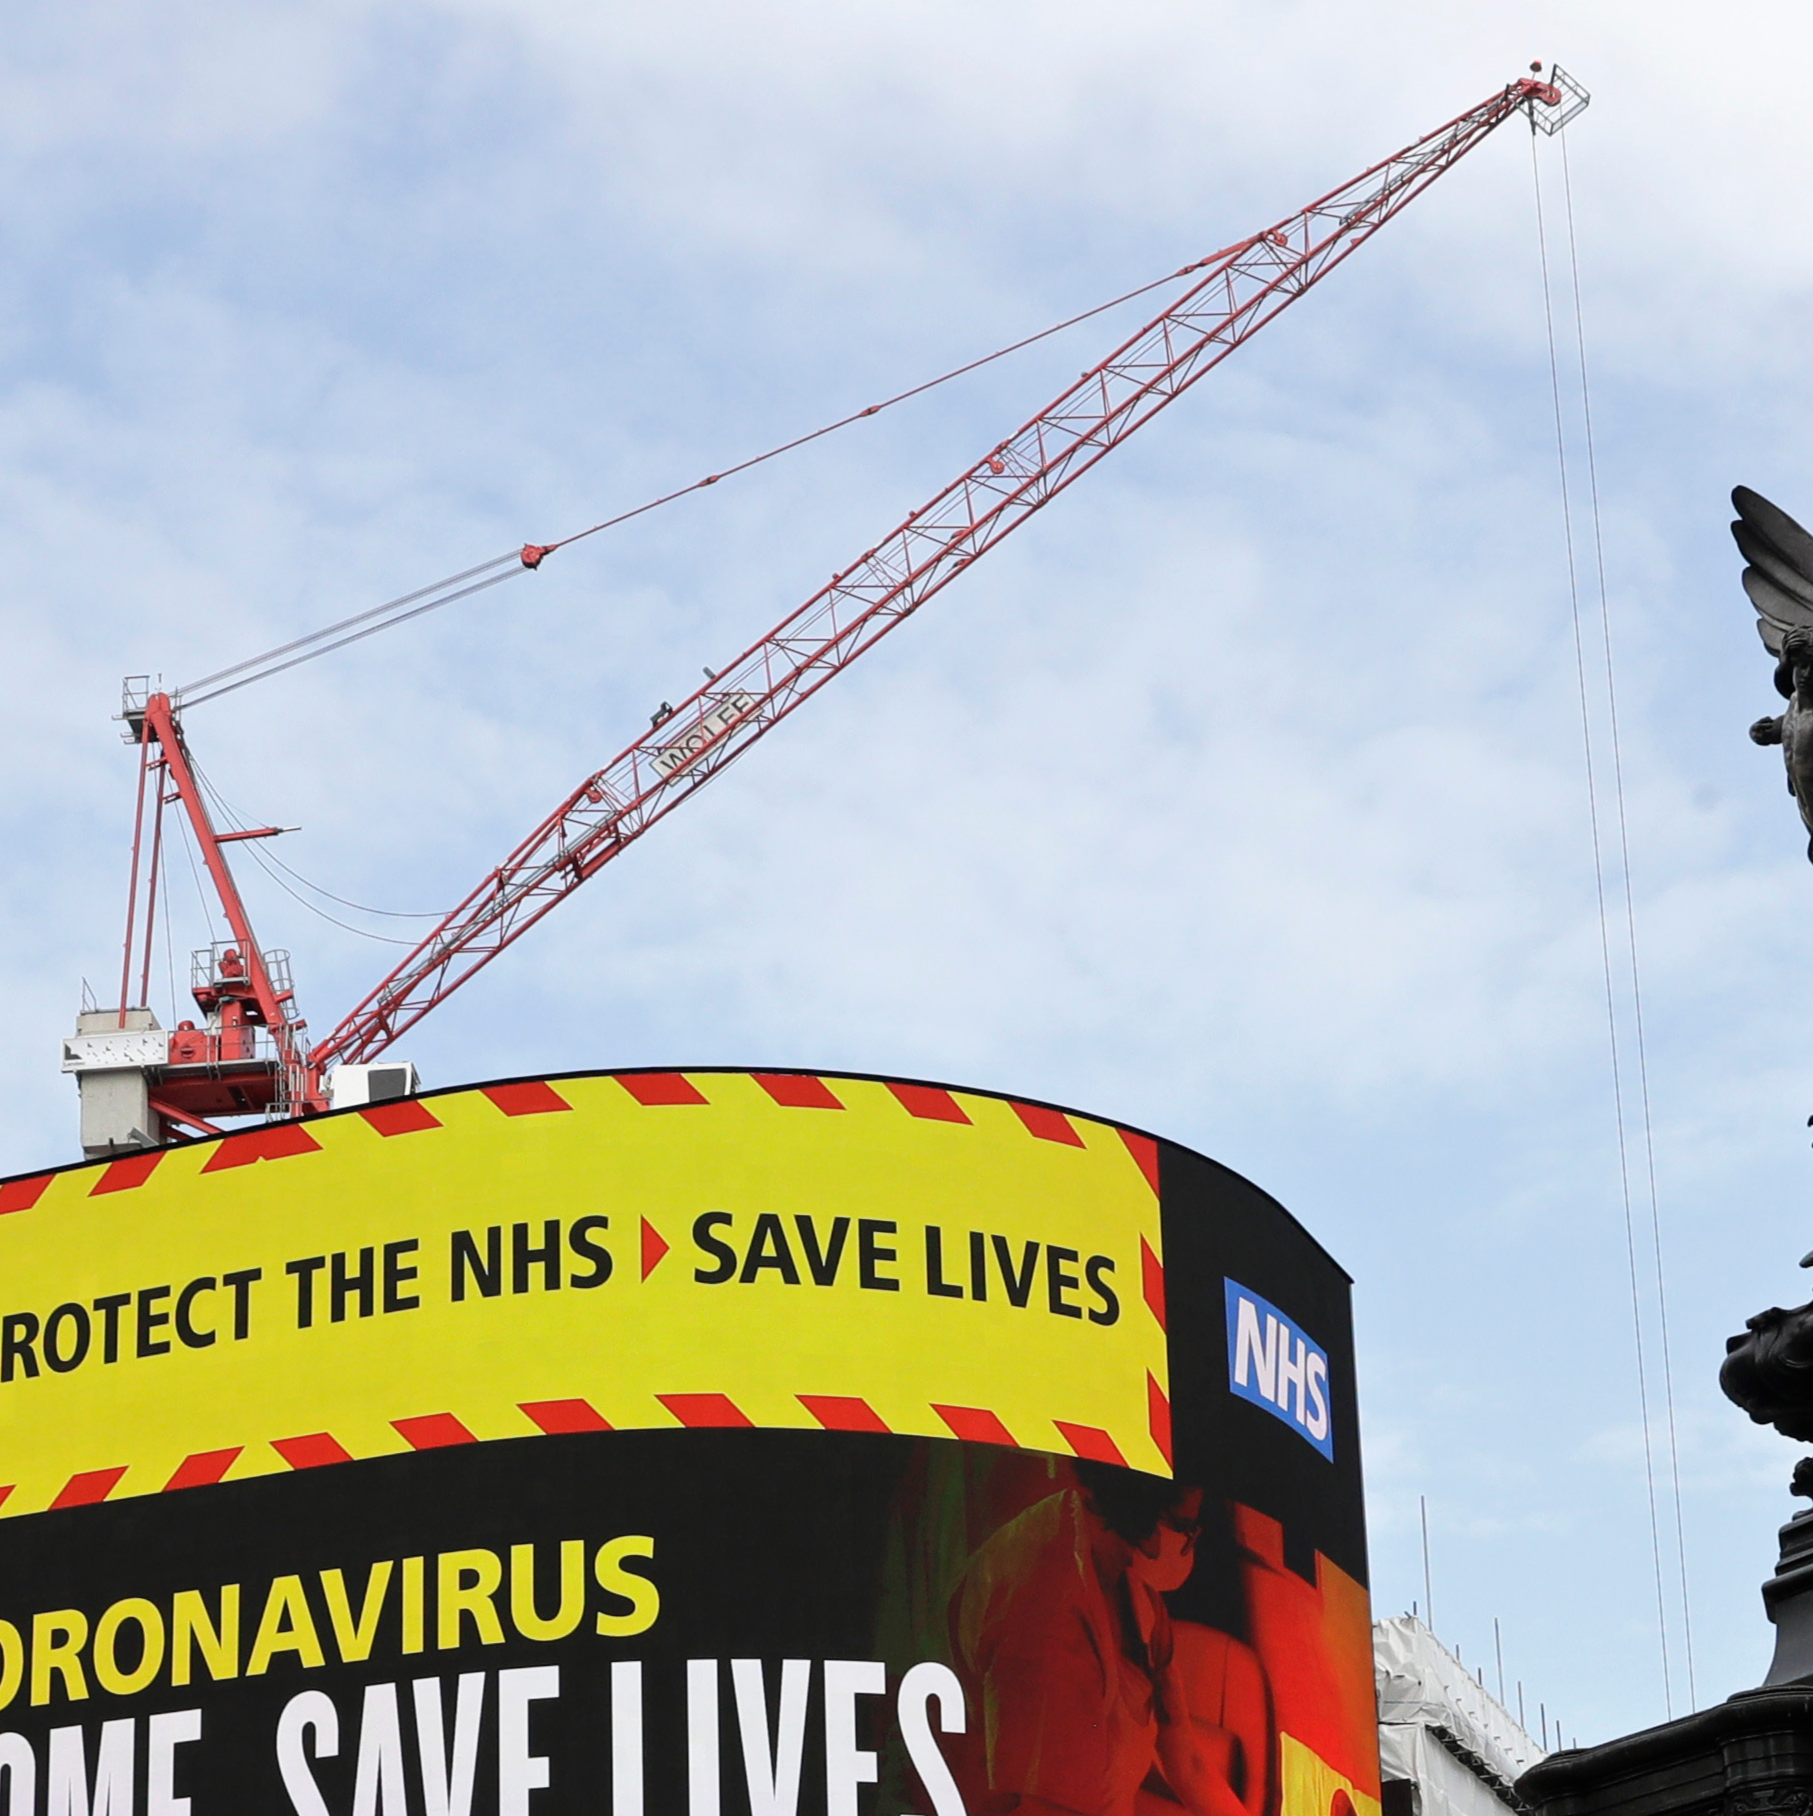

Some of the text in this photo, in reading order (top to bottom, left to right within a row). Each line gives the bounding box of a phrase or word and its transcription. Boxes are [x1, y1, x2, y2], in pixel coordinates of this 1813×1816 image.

[286, 1237, 421, 1330] THE
[450, 1214, 614, 1303] NHS
[691, 1211, 900, 1292] SAVE
[924, 1224, 1121, 1327] LIVES
[1233, 1297, 1328, 1442] NHS
